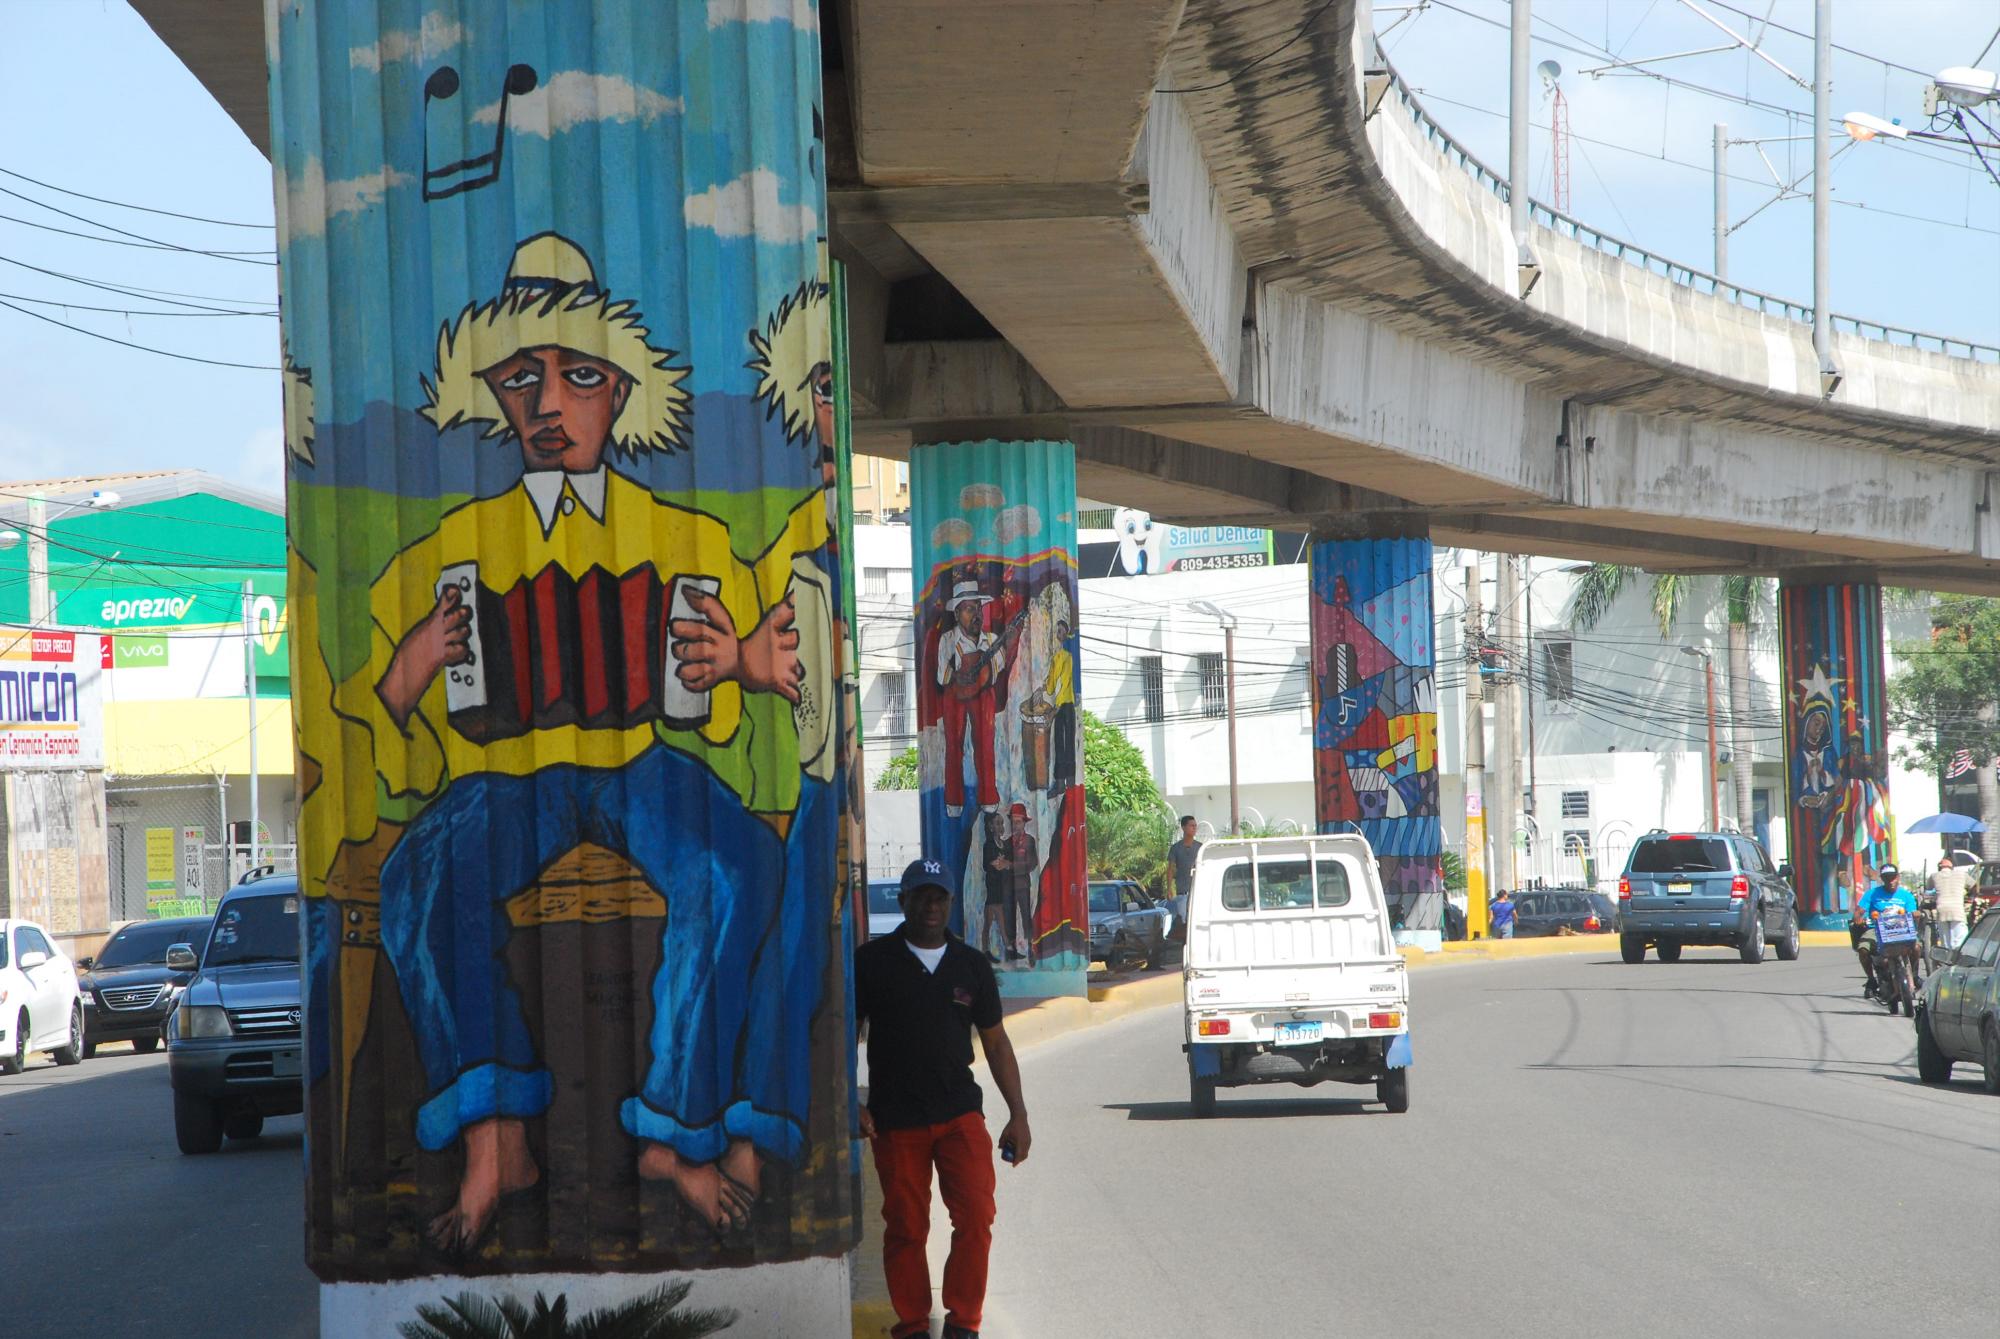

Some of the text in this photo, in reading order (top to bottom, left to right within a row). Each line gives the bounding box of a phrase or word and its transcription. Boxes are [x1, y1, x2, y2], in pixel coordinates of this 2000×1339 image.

[1169, 525, 1264, 546] Salud Dental
[1180, 554, 1263, 571] 809-435-5353
[924, 860, 941, 874] NY
